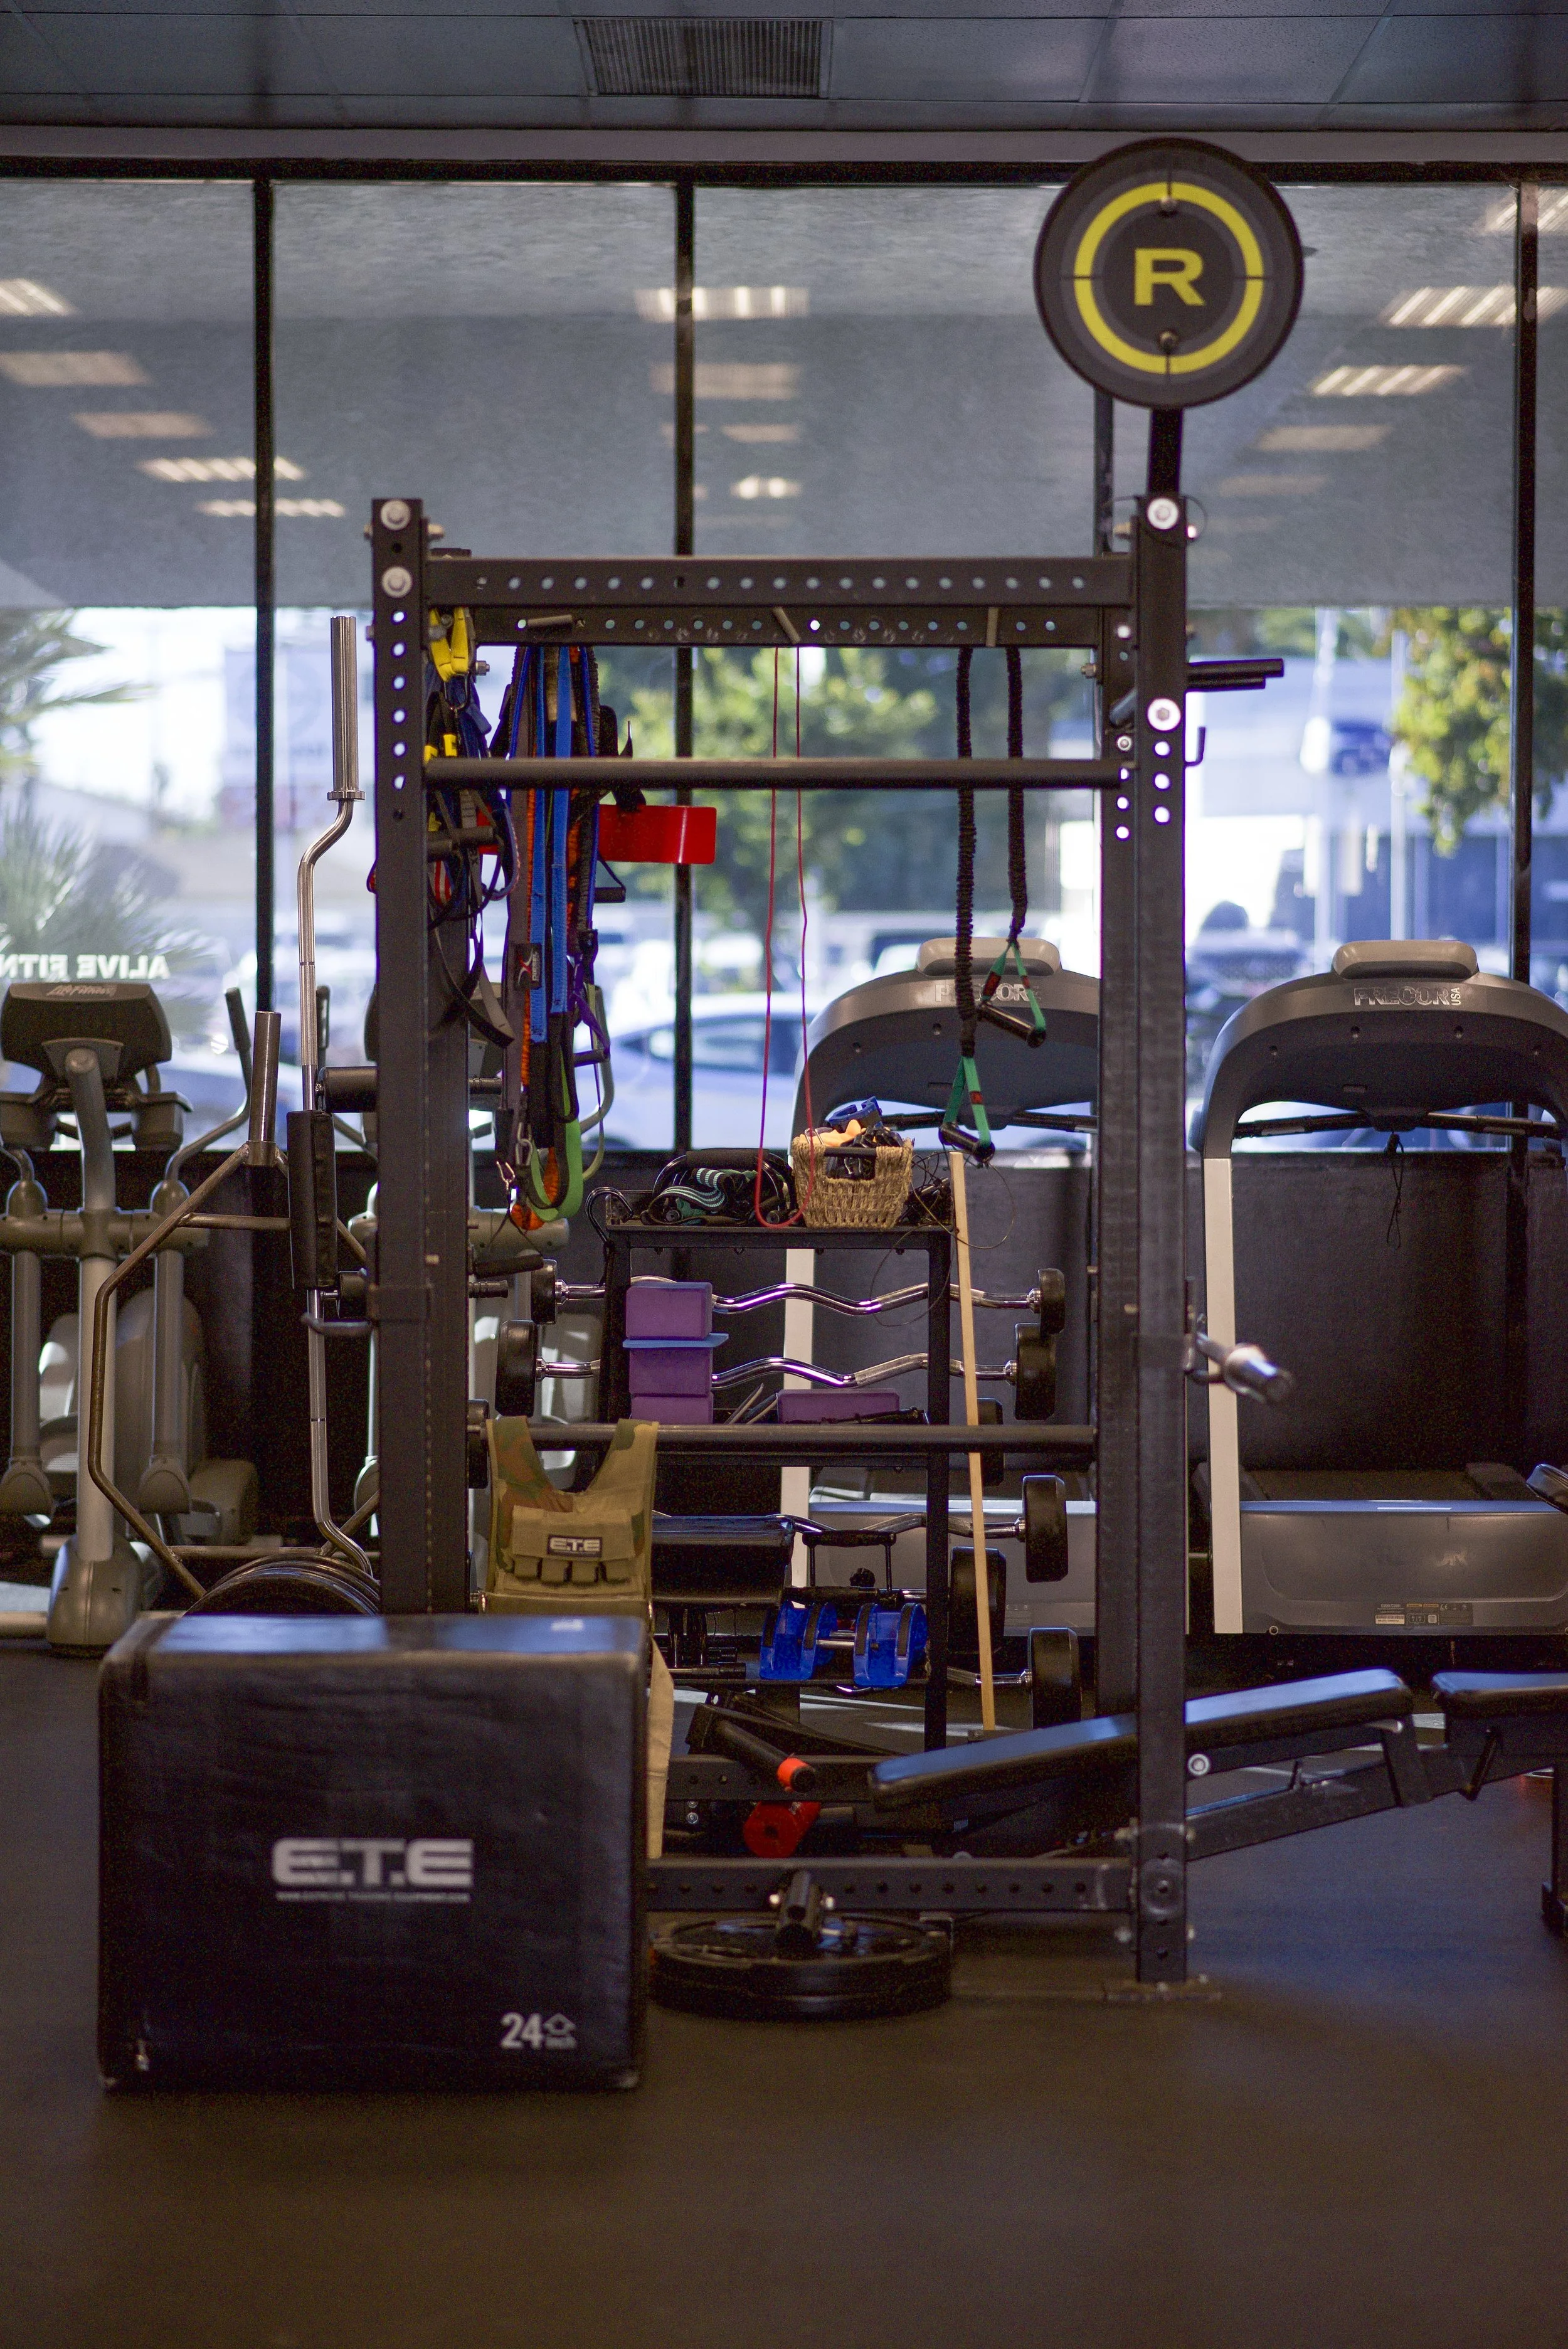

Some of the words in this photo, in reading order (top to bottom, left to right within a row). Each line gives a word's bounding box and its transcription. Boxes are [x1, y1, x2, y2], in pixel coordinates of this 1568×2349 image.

[1134, 248, 1205, 305] R
[1354, 986, 1449, 1005] PRECOR
[1450, 987, 1461, 1006] USA
[272, 1837, 473, 1886] E.T.E
[501, 2012, 543, 2049] 24
